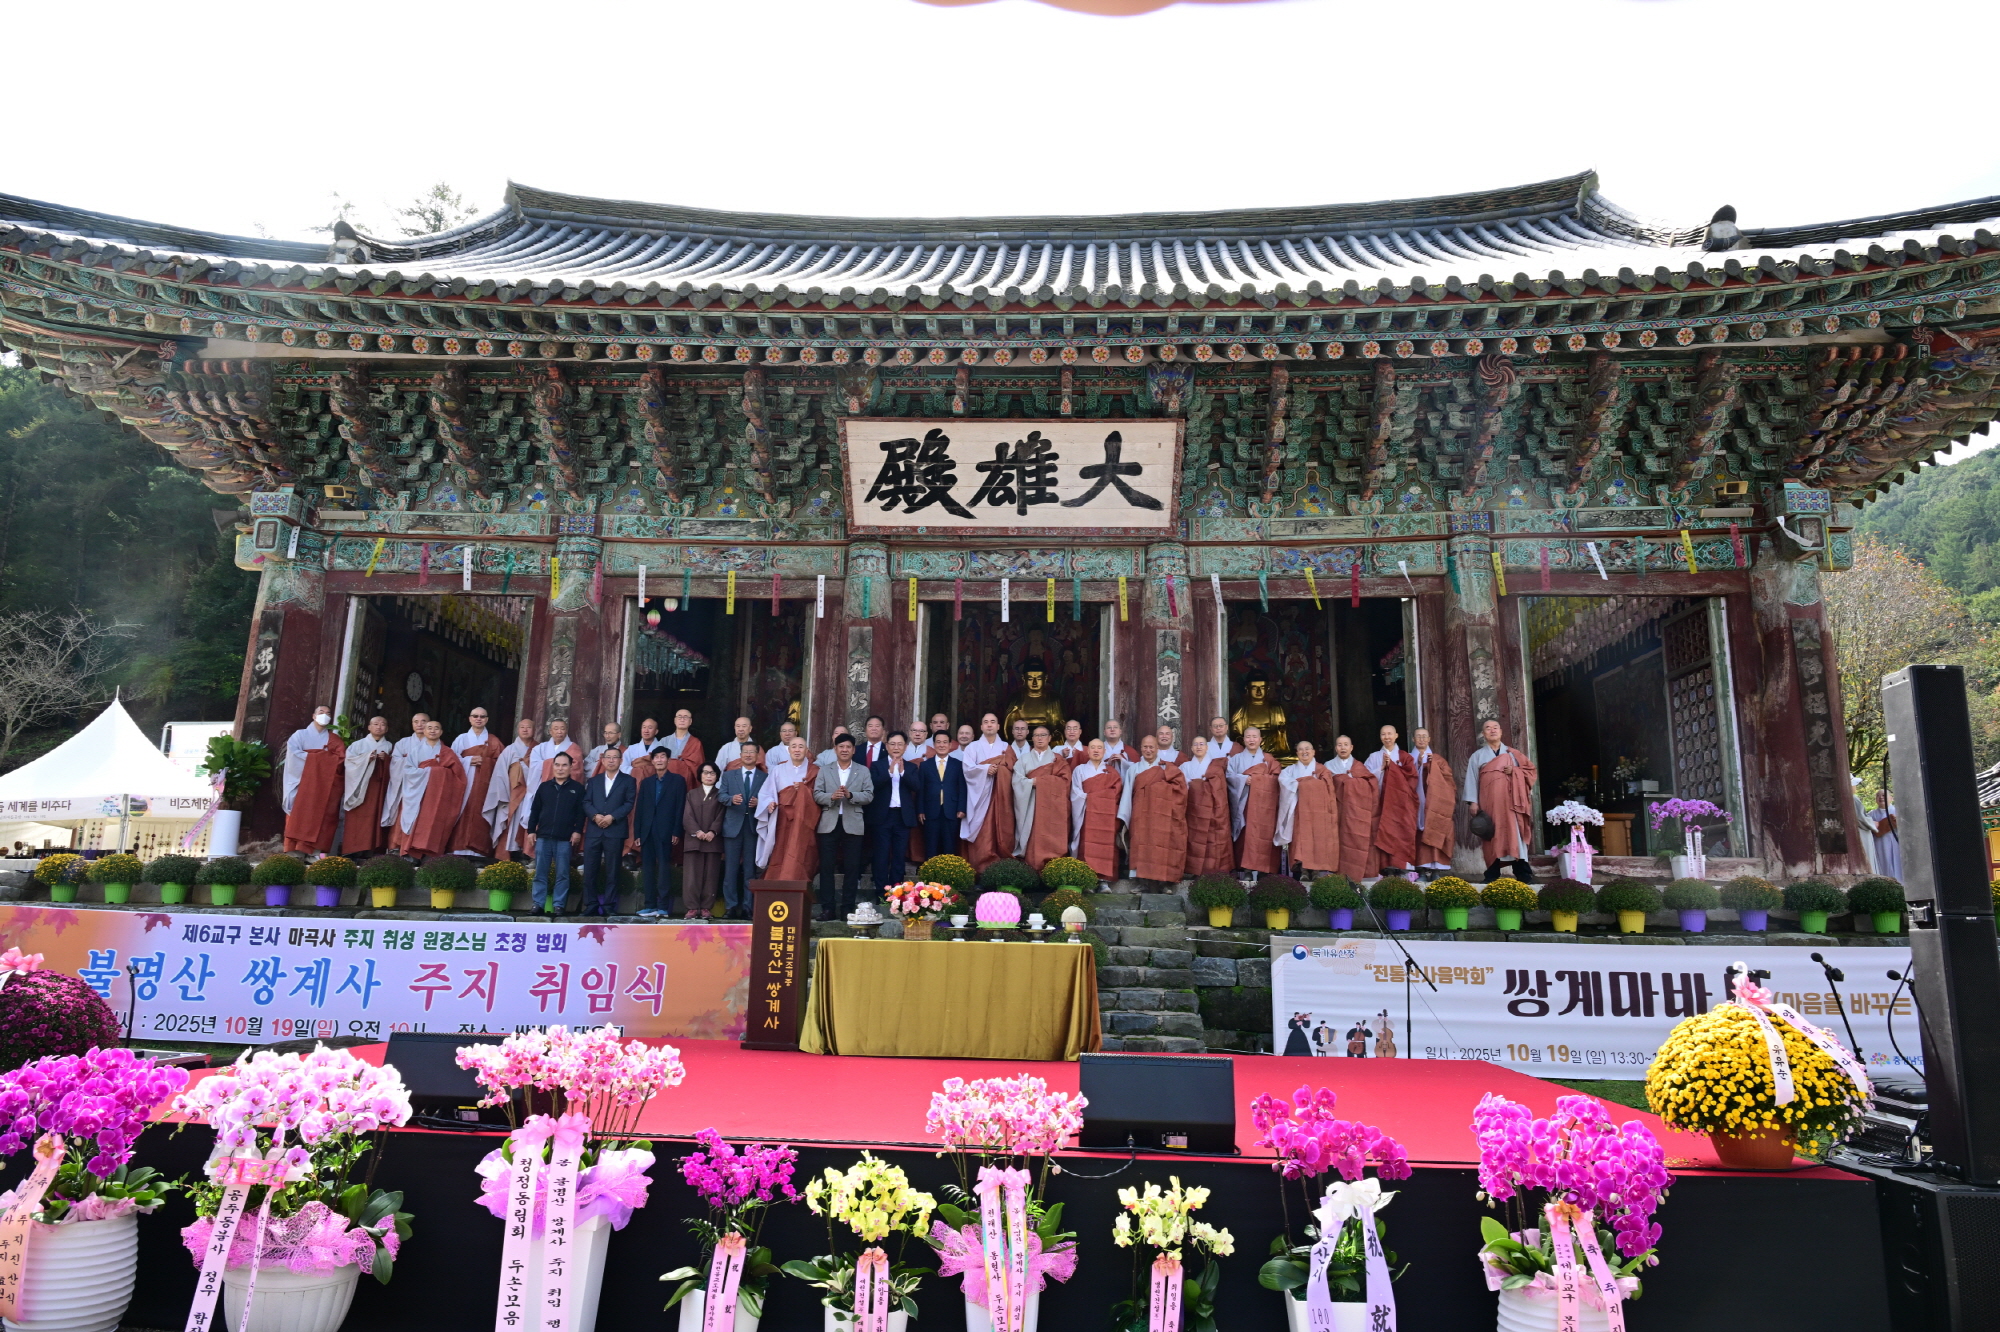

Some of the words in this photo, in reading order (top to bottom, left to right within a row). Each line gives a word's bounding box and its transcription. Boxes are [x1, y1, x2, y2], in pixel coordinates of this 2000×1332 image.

[8, 801, 38, 812] 세계를
[41, 799, 71, 811] 비주다
[182, 923, 242, 946] 제6교구
[249, 925, 281, 947] 본사
[288, 926, 336, 948] 마곡사
[343, 928, 375, 949] 주지
[383, 929, 416, 951] 취성
[423, 930, 487, 952] 원경스님
[494, 931, 527, 953] 초청
[536, 932, 568, 954] 법회
[768, 925, 785, 974] 불명산
[78, 949, 216, 1002] 불명산
[241, 955, 382, 1010] 쌍계사
[408, 961, 501, 1013] 주지
[529, 961, 668, 1016] 취임식
[763, 982, 782, 1030] 쌍계사
[1850, 992, 1912, 1017] 바꾸는
[154, 1013, 217, 1035] 2025년
[225, 1016, 263, 1037] 10월
[271, 1018, 339, 1039] 19일(일)
[1425, 1046, 1449, 1060] 일시
[1459, 1047, 1502, 1062] 2025년
[1506, 1043, 1543, 1063] 10월
[1546, 1044, 1583, 1064] 19일
[510, 1157, 533, 1240] 청정동림회
[549, 1216, 567, 1247] 쌍계사
[548, 1257, 566, 1277] 주지
[1561, 1260, 1576, 1304] 제6교구
[200, 1270, 218, 1297] 정우
[503, 1259, 525, 1326] 두손모음
[547, 1287, 562, 1308] 취임
